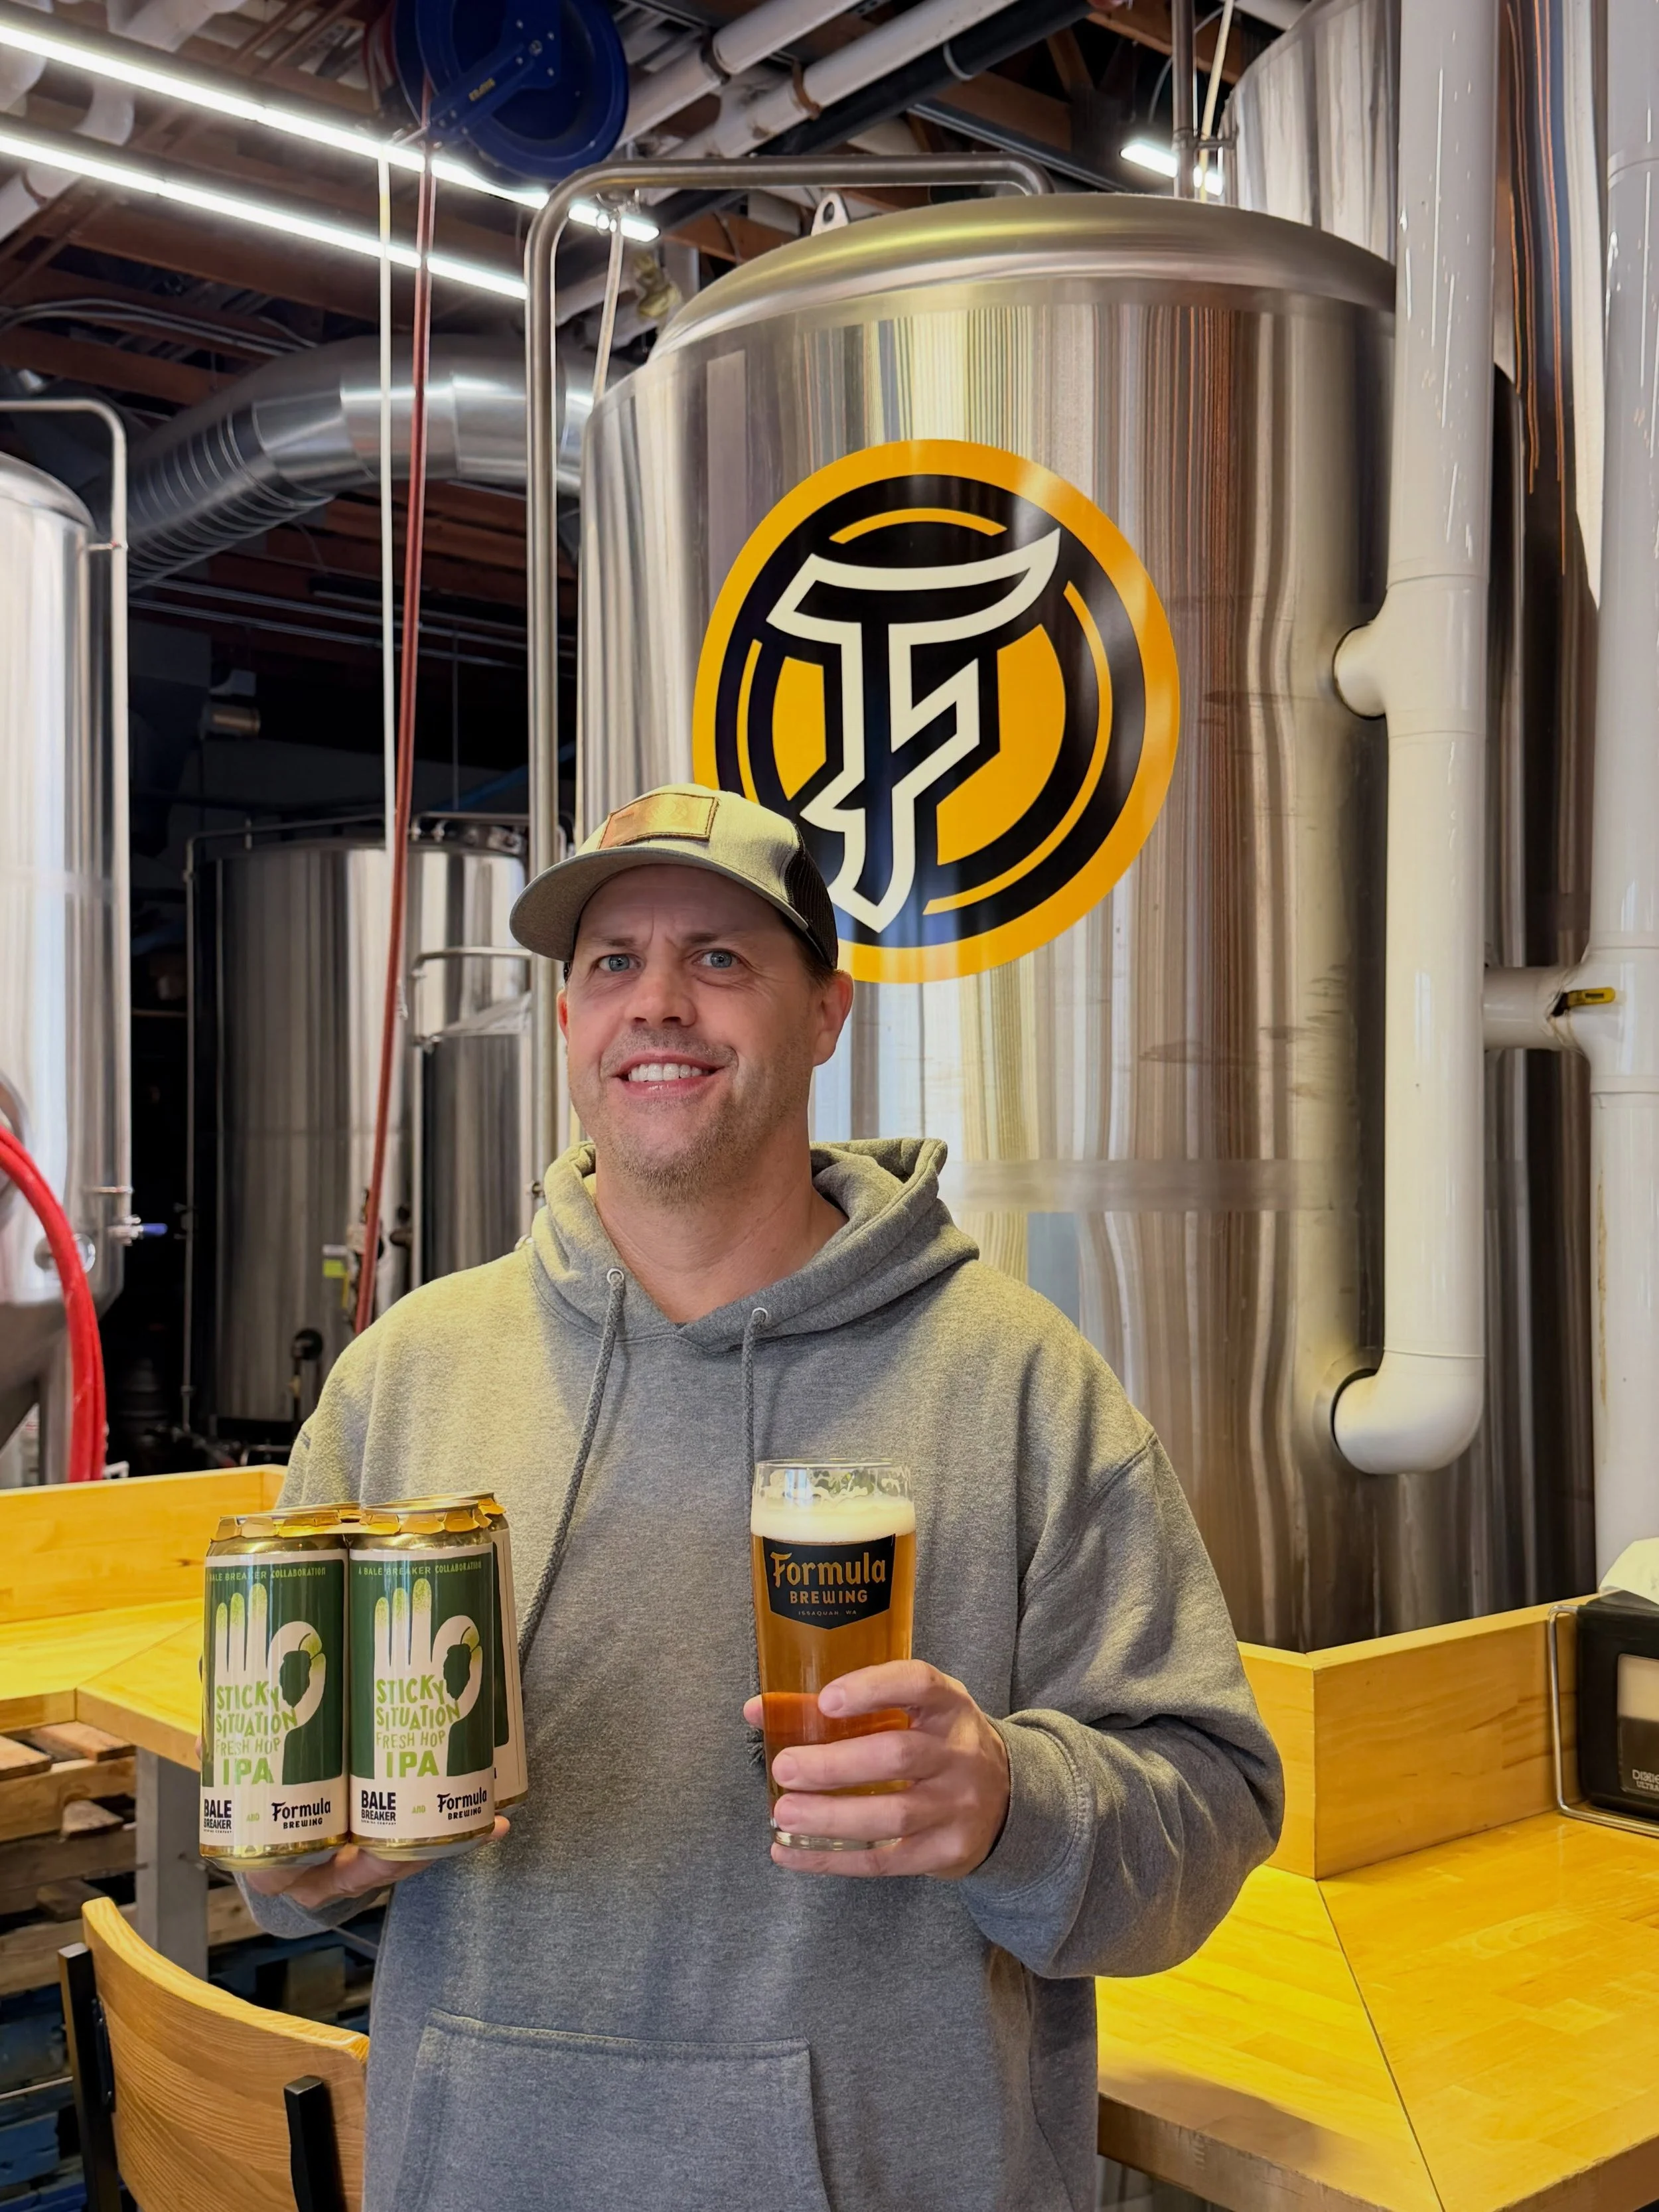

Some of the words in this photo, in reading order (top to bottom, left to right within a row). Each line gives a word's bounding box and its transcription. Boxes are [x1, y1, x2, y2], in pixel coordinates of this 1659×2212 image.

[271, 1567, 326, 1578] COLLABORATION
[364, 1567, 383, 1576] BALE
[435, 1561, 482, 1574] COLLABORATION
[770, 1551, 887, 1588] Formula
[790, 1589, 868, 1604] BREWING
[216, 1680, 279, 1712] STICKY
[376, 1674, 445, 1705] STICKY
[216, 1708, 298, 1738] SITUATION
[376, 1700, 461, 1731] SITUATION
[216, 1739, 250, 1757] FRESH
[255, 1737, 281, 1755] HOP
[376, 1732, 415, 1749] FRESH
[420, 1730, 446, 1747] HOP
[223, 1757, 275, 1785] IPA
[386, 1750, 439, 1778] IPA
[204, 1799, 232, 1818] BALE
[271, 1797, 331, 1822] Formula
[361, 1790, 396, 1810] BALE
[411, 1805, 426, 1814] AND
[437, 1787, 487, 1813] Formula
[246, 1813, 259, 1822] AND
[361, 1809, 396, 1821] BREAKER
[448, 1806, 482, 1820] BREWING
[204, 1818, 232, 1830] BREAKER
[283, 1817, 323, 1830] BREWING
